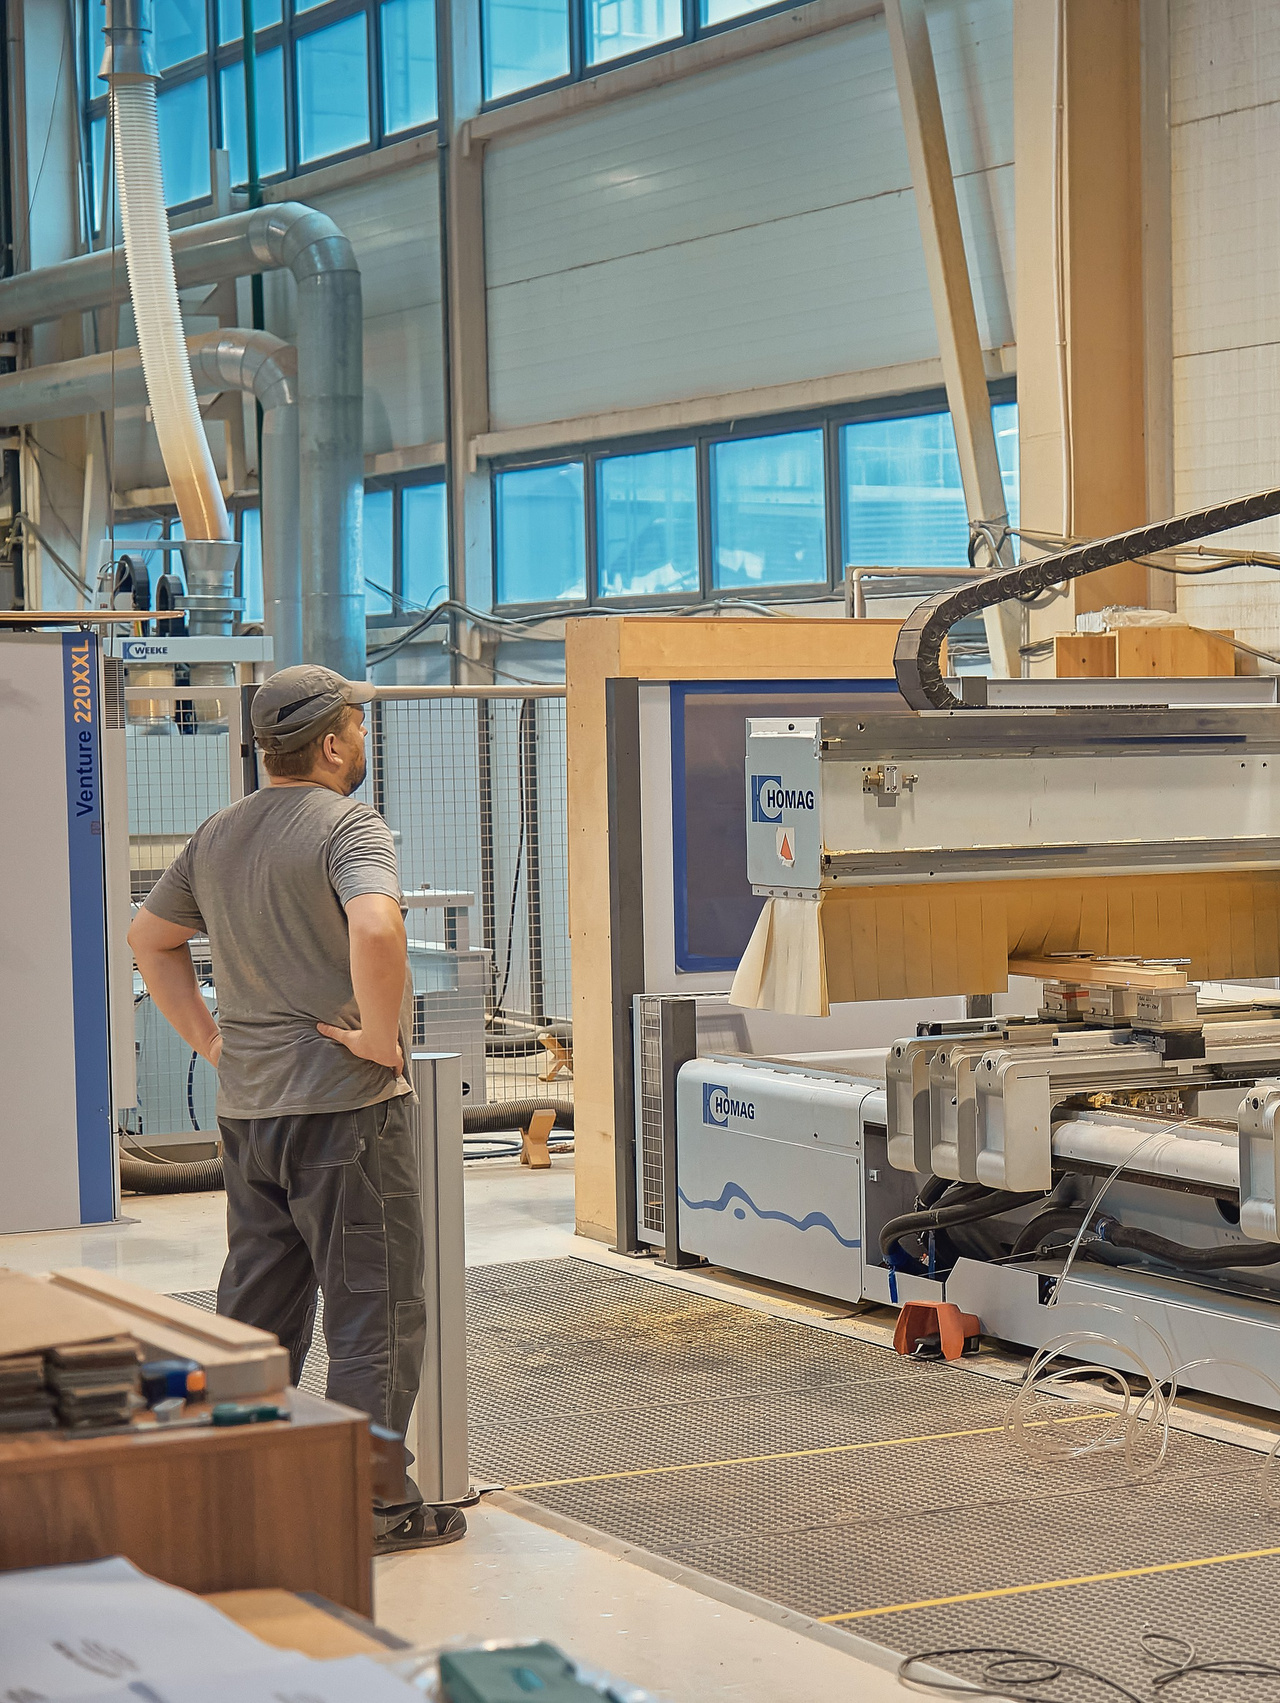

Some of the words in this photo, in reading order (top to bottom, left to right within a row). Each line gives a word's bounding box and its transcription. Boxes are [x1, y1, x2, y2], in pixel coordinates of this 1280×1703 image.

[134, 646, 168, 654] WEEKE
[71, 639, 92, 724] 220XXL
[76, 730, 94, 818] Venture
[767, 788, 814, 811] HOMAG
[715, 1096, 755, 1120] HOMAG
